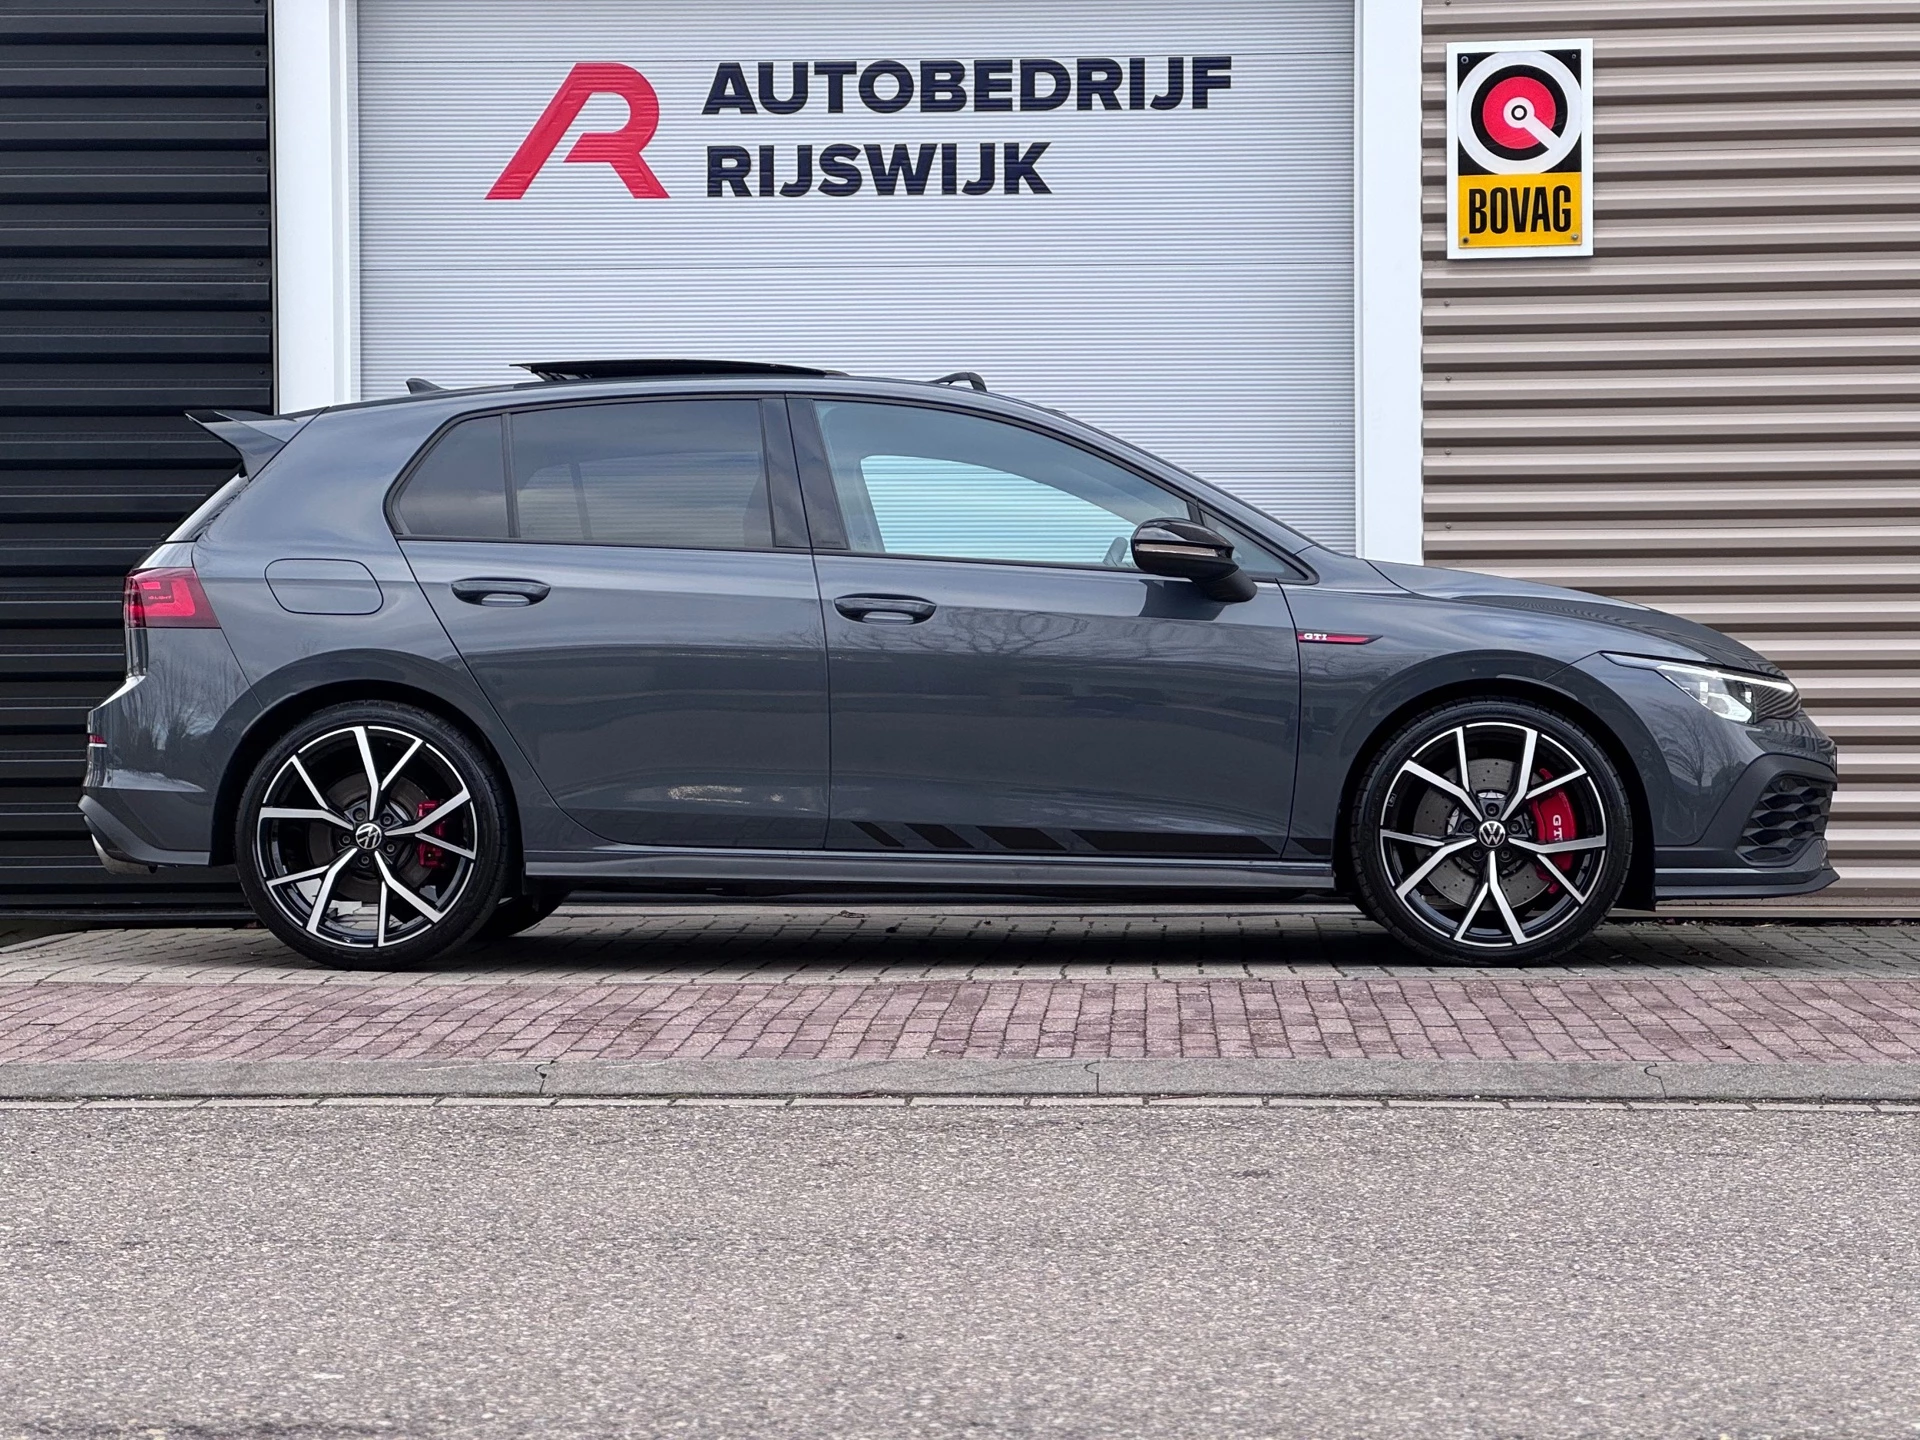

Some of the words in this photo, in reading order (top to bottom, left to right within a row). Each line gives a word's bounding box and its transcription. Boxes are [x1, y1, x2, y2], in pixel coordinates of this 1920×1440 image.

[702, 56, 1232, 115] AUTOBEDRIJF
[706, 141, 1053, 198] RIJSWIJK
[1468, 184, 1572, 235] BOVAG
[1303, 632, 1328, 641] GTI
